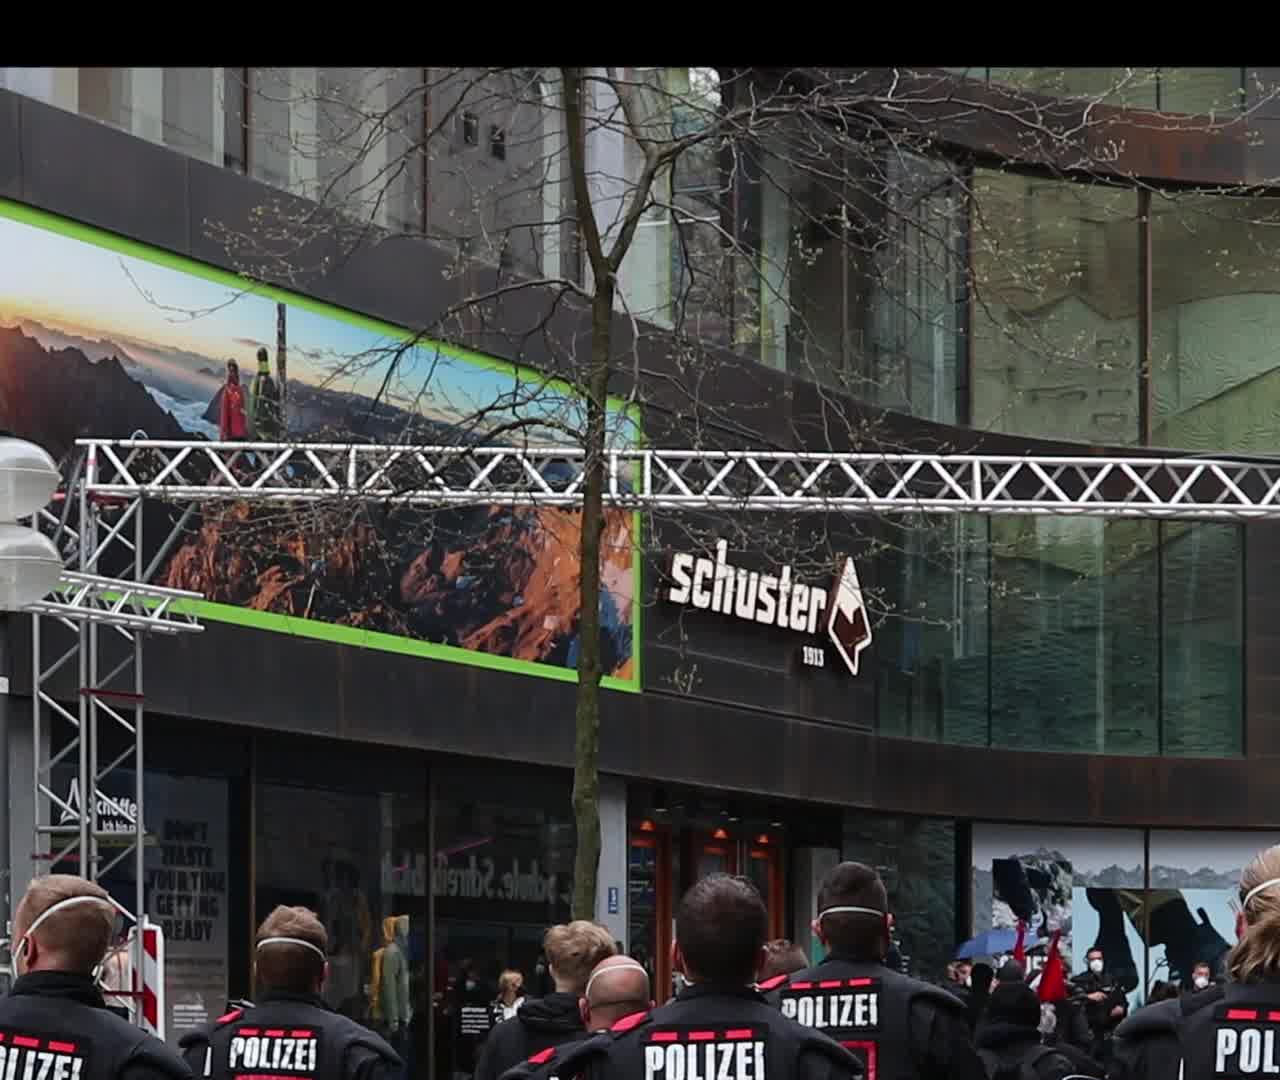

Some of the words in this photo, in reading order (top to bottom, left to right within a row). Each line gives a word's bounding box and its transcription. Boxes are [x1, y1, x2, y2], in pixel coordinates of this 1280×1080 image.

[669, 539, 828, 635] schuster
[803, 645, 825, 667] 1913
[163, 919, 212, 942] READY
[228, 1036, 318, 1071] POLIZEI
